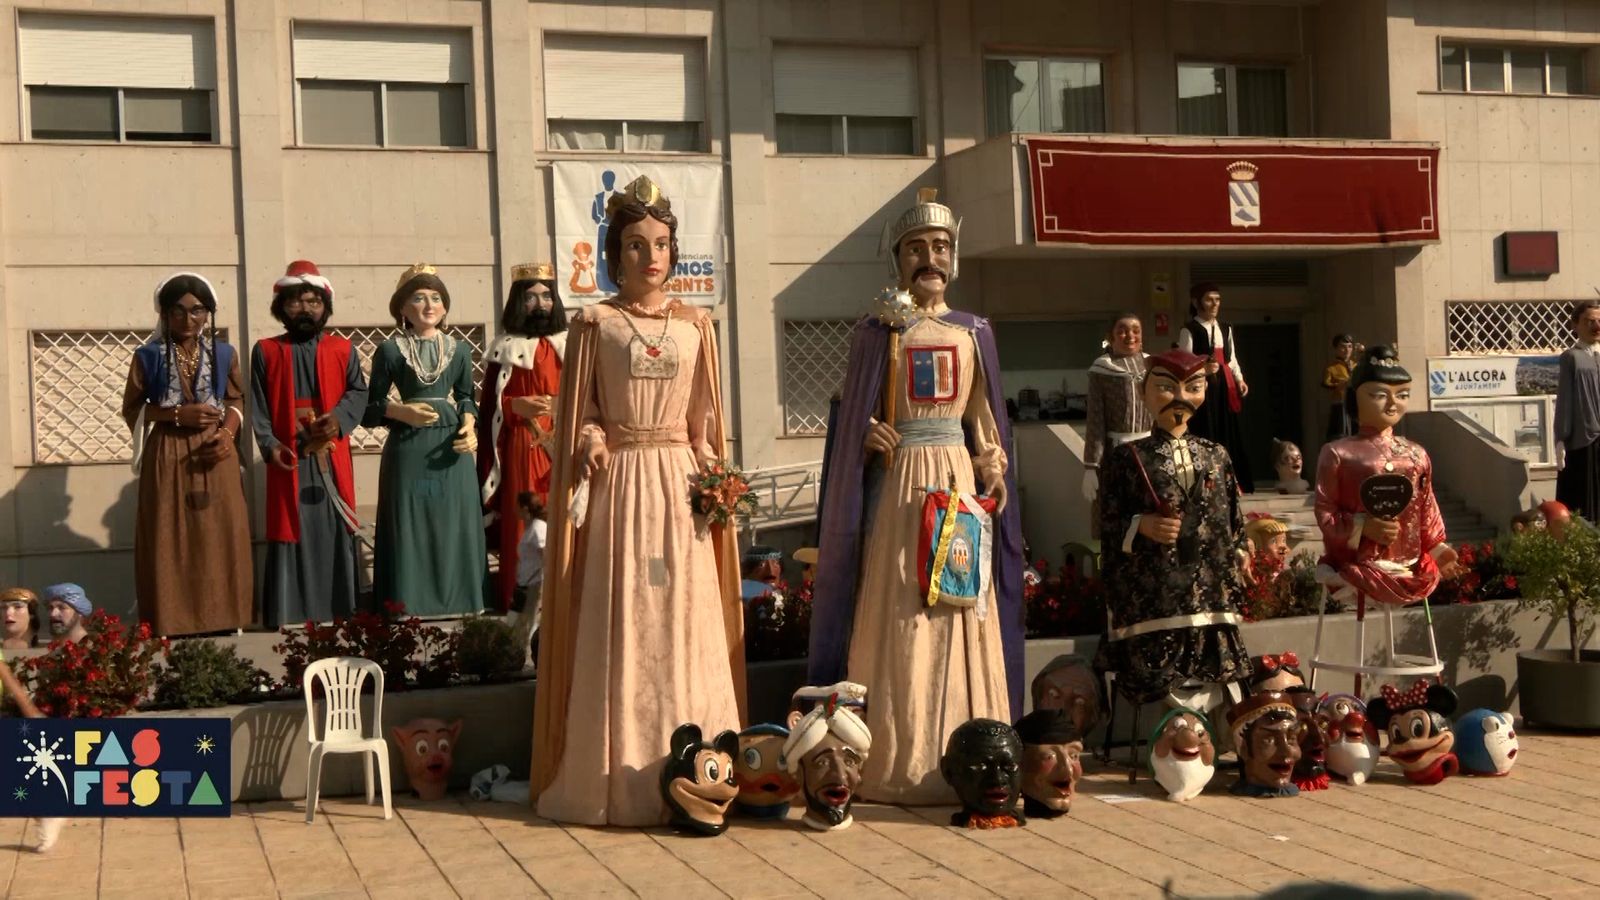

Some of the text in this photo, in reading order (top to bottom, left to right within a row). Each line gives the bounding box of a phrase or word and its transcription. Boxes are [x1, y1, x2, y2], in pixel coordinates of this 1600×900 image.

[671, 261, 713, 276] NOS
[1448, 369, 1506, 382] L'ALCORA
[1455, 382, 1501, 390] AJUNTAMENT
